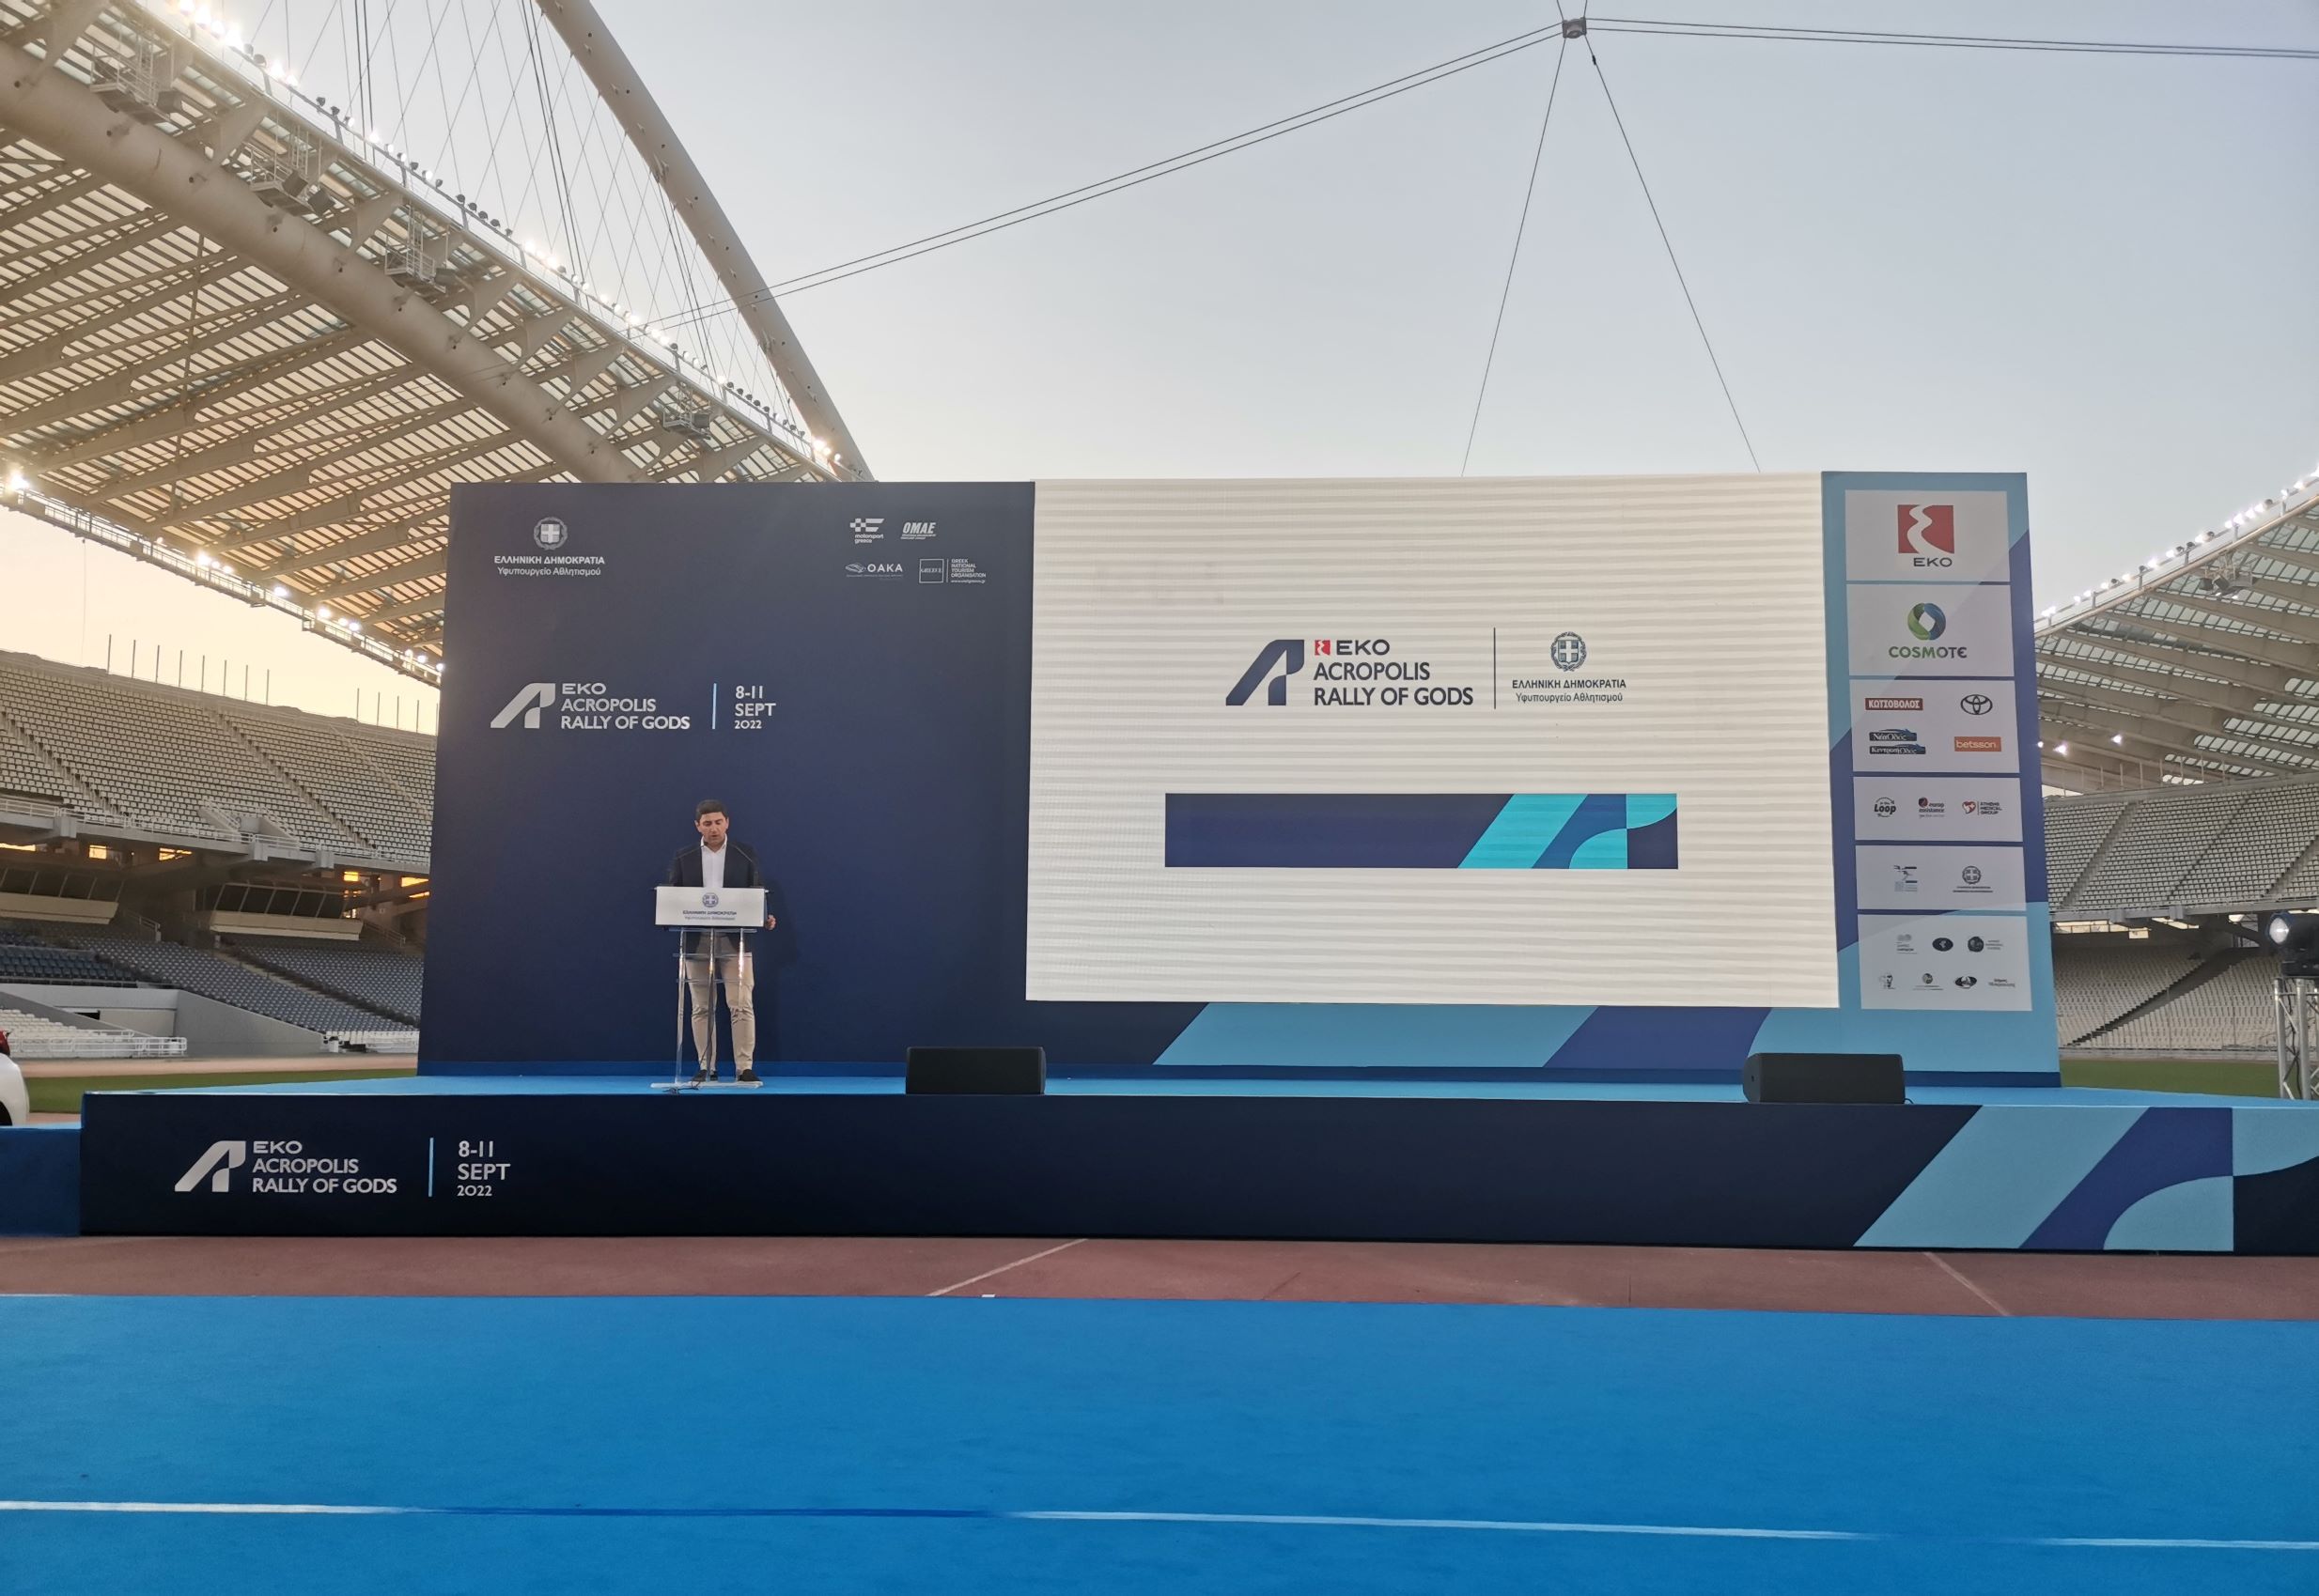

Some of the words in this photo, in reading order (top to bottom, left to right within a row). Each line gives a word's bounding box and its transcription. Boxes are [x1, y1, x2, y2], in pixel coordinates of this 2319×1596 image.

[903, 522, 936, 534] OMAE
[866, 563, 903, 573] OAKA
[1913, 557, 1953, 567] EKO
[498, 567, 552, 576] Υφυπουργείο
[553, 567, 600, 576] Αθλητισμού
[1337, 639, 1390, 656] EKO
[1314, 662, 1430, 680] ACROPOLIS
[562, 683, 606, 694] EKO
[1513, 680, 1561, 689] ΕΛΛΗΝΙΚΗ
[1564, 679, 1626, 689] ΔΗΜΟΚΡΑΤΙΑ
[736, 686, 763, 699] 8-11
[1315, 688, 1376, 705] RALLY
[1380, 688, 1409, 705] OF
[1415, 688, 1473, 705] GODS
[1516, 693, 1571, 704] Υφυπουργείο
[1574, 692, 1623, 703] Αθλητισμού
[561, 699, 656, 711] ACROPOLIS
[735, 703, 776, 716] SEPT
[1869, 700, 1920, 708] ΚΩΤΣΟΒΟΛΟΣ
[561, 716, 611, 729] RALLY
[615, 716, 638, 729] OF
[642, 716, 690, 729] GODS
[735, 720, 761, 729] 2022
[1955, 739, 1997, 749] betsson
[1874, 804, 1897, 814] Loop
[254, 1140, 302, 1154] EKO
[459, 1140, 493, 1157] 8-11
[253, 1158, 358, 1173] ACROPOLIS
[459, 1164, 510, 1180] SEPT
[253, 1178, 308, 1192] RALLY
[313, 1179, 338, 1193] OF
[343, 1179, 397, 1193] GODS
[458, 1185, 491, 1196] 2022
